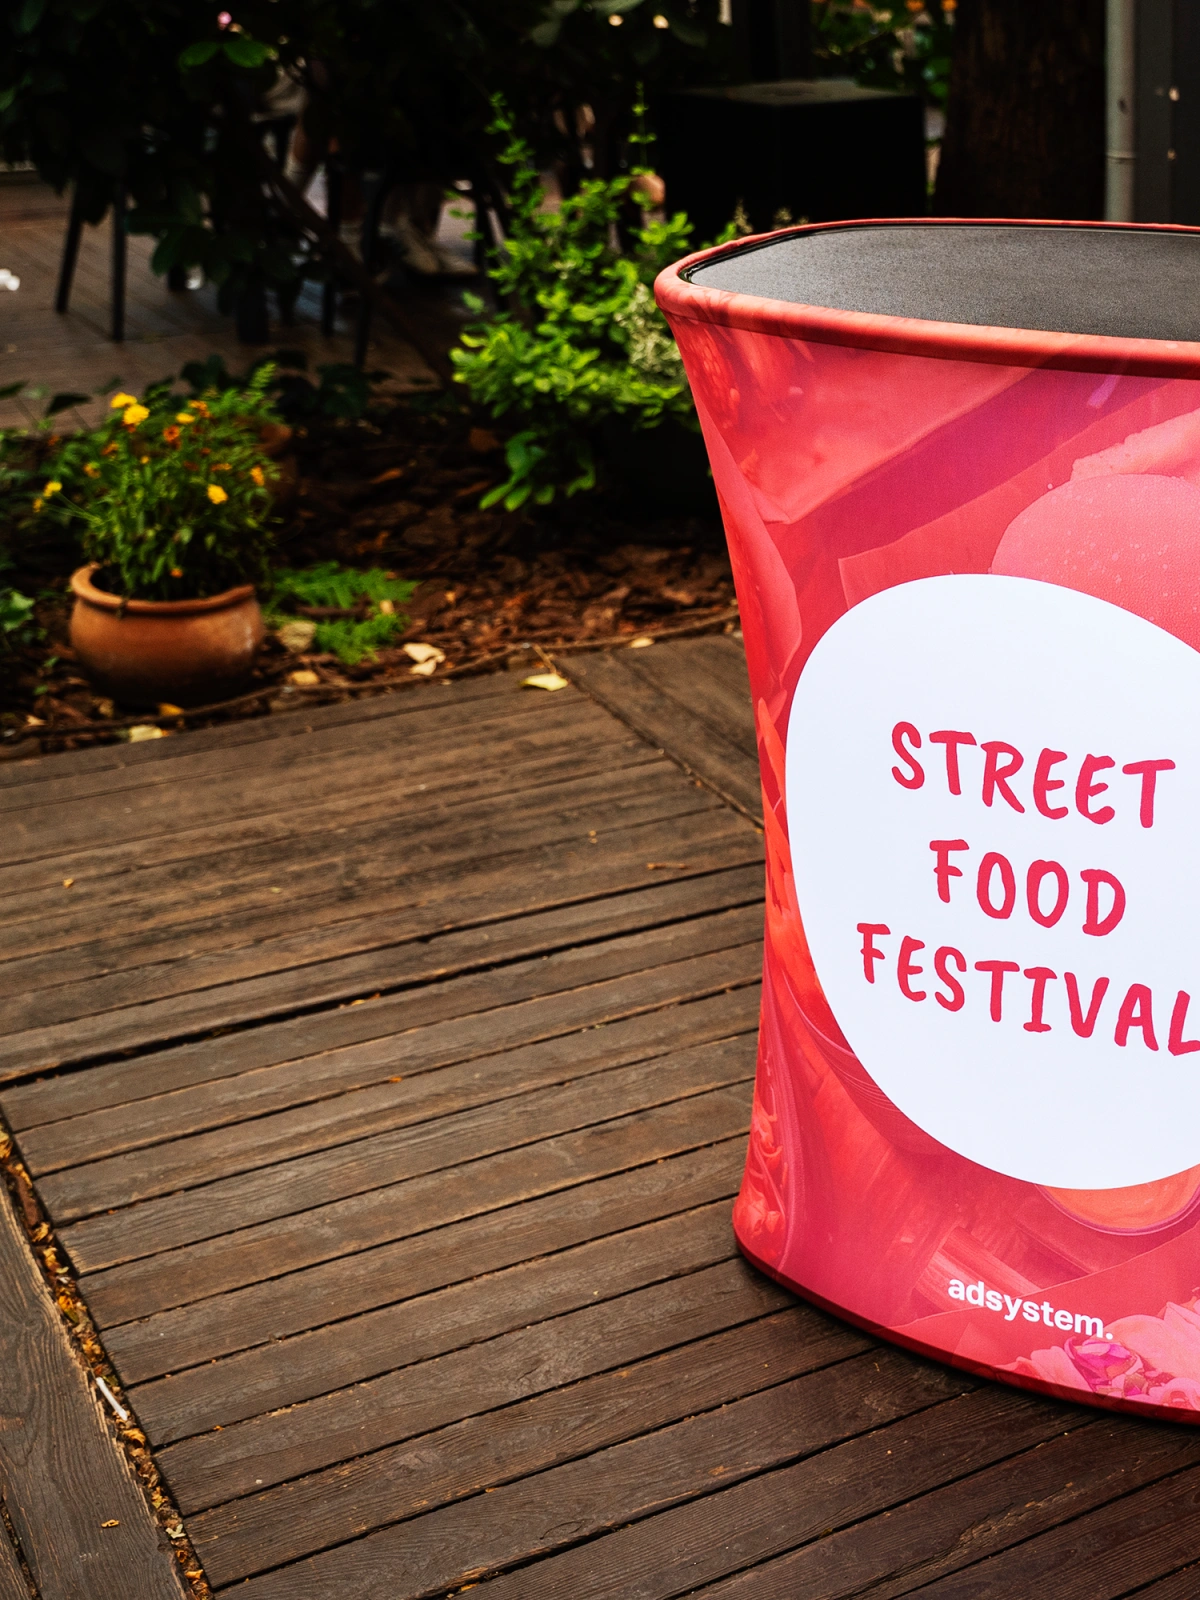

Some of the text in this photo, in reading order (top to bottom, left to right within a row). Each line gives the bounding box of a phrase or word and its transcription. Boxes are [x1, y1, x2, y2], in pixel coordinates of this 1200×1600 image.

[891, 721, 1176, 828] STREET
[929, 839, 1126, 937] FOOD
[947, 1279, 1114, 1341] adsystem.
